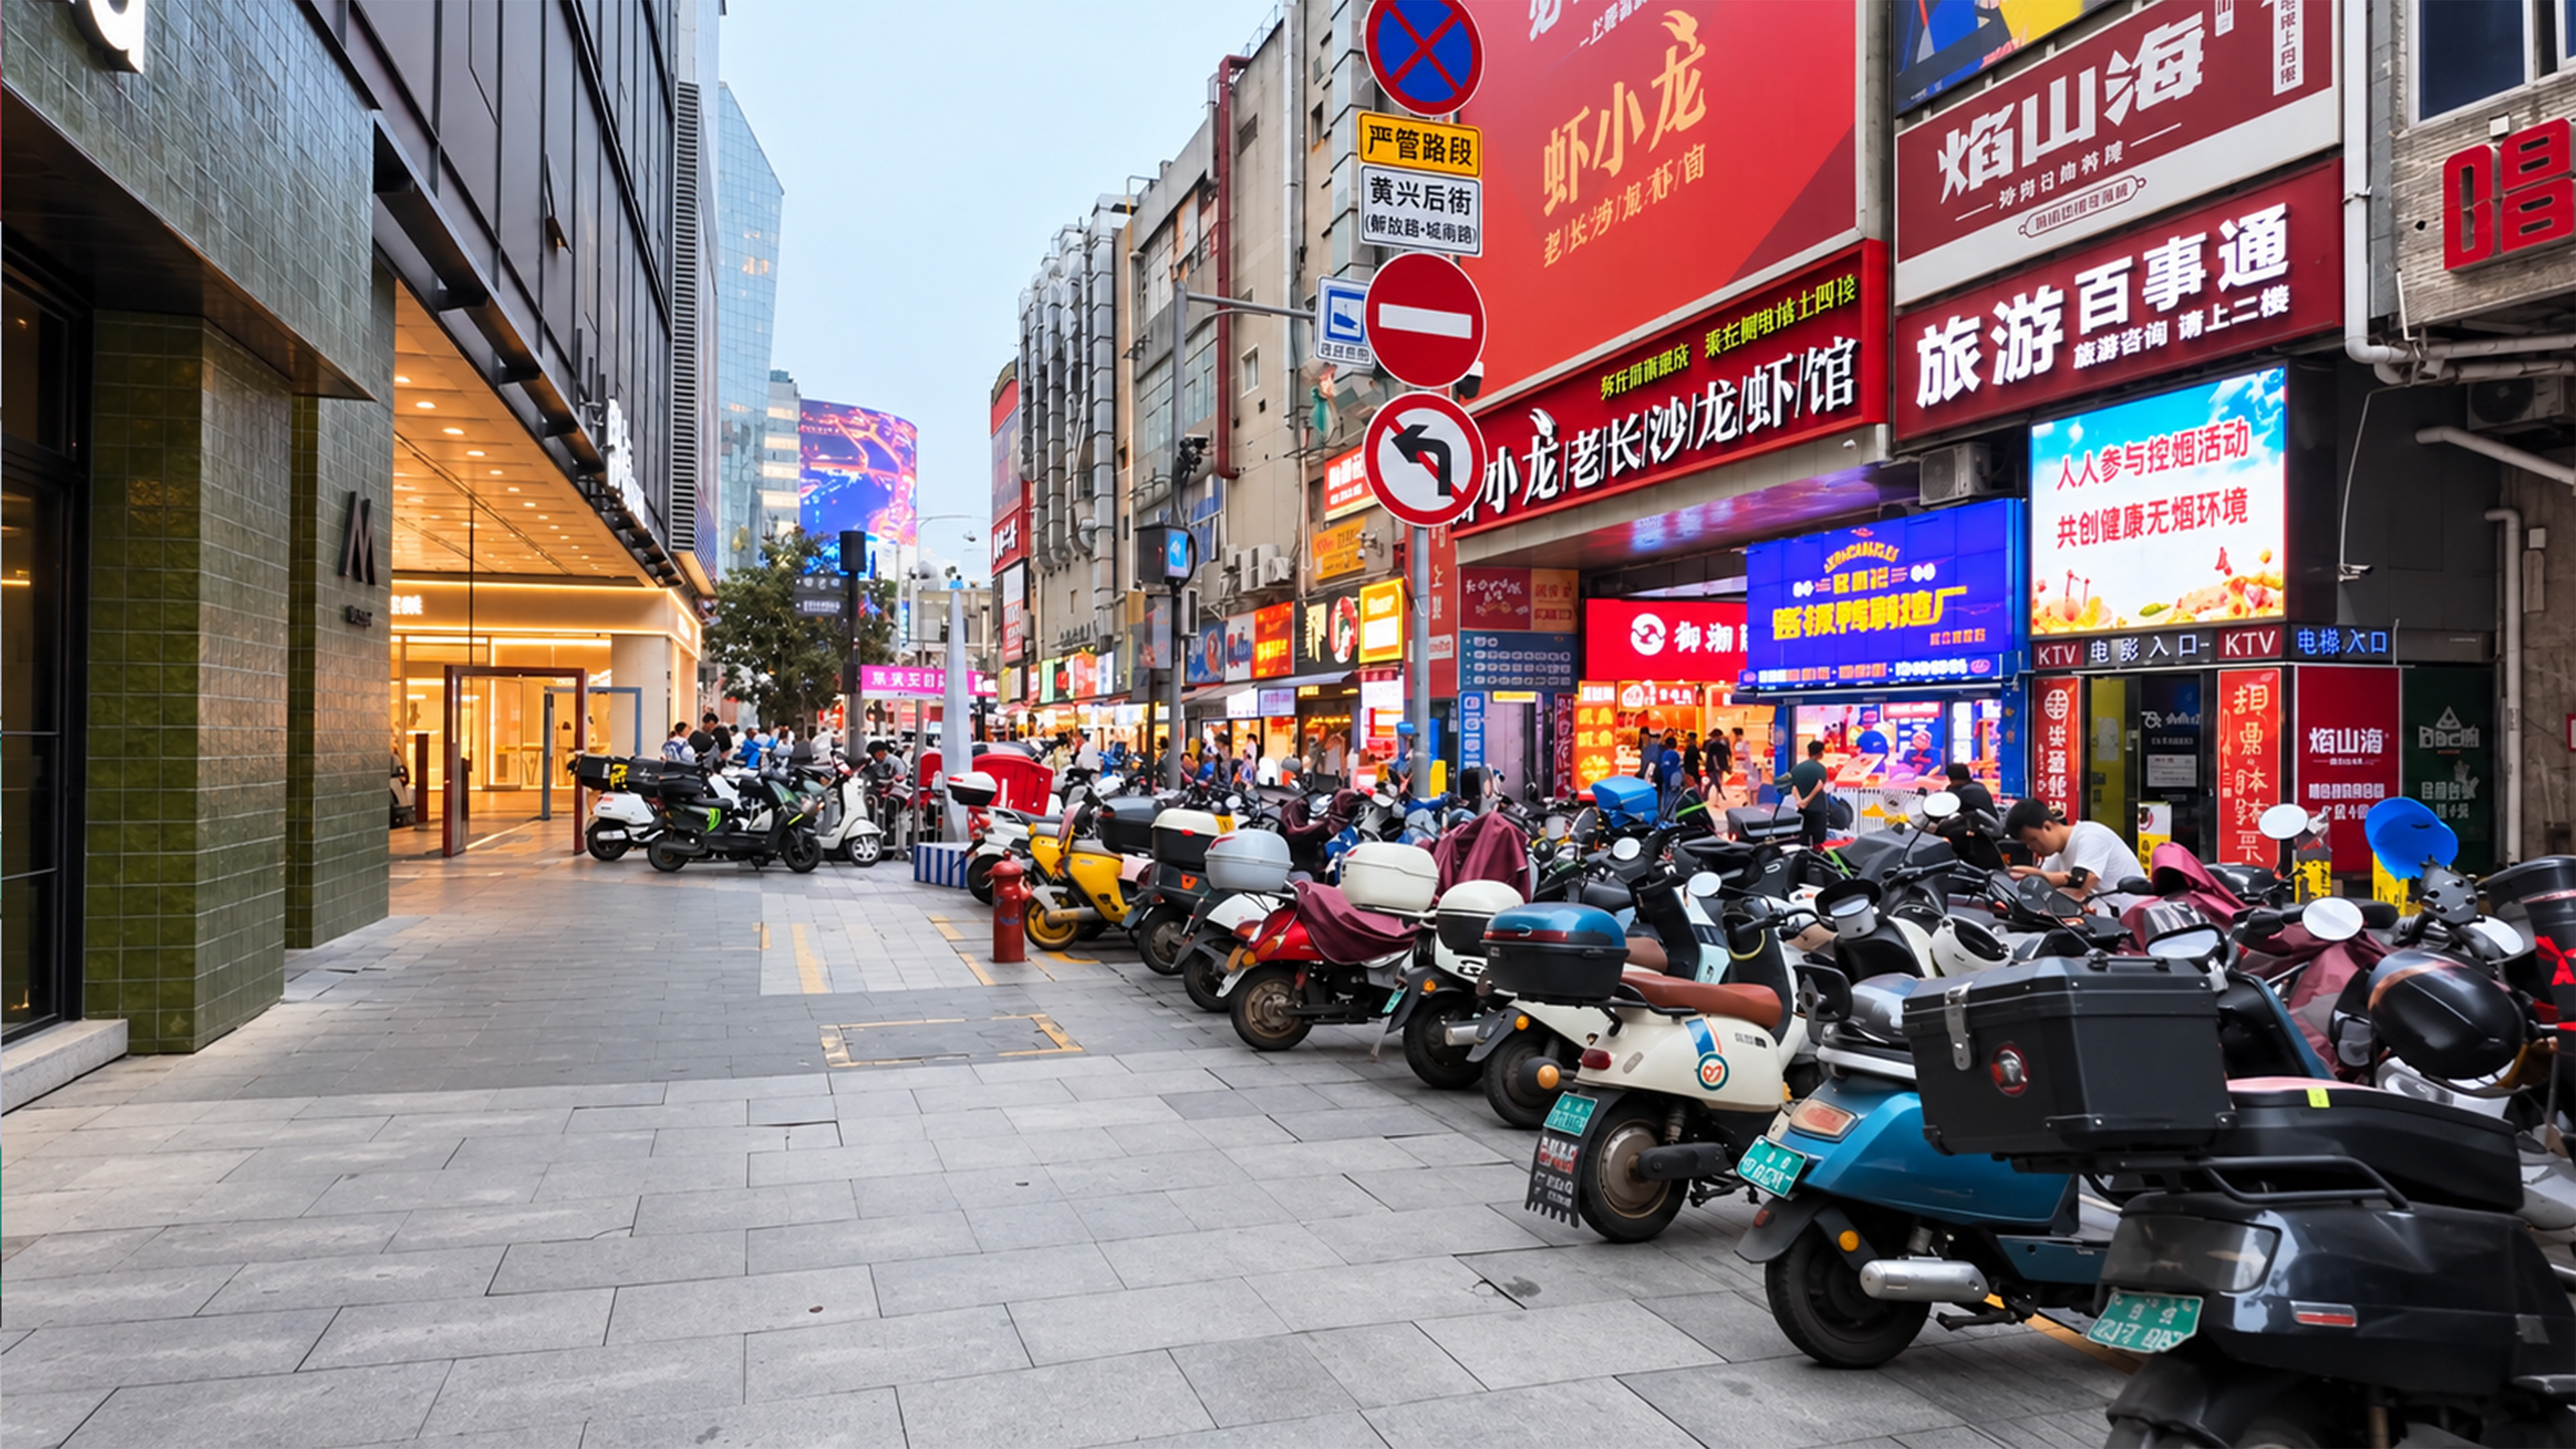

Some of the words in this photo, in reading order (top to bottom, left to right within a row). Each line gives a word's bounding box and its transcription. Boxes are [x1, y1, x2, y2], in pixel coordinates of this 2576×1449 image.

[1544, 11, 1707, 217] 虾小龙
[1937, 11, 2205, 204] 焰山海
[1368, 125, 1472, 166] 严管路段
[1370, 175, 1472, 216] 黄兴后街
[1916, 202, 2290, 409] 旅游百事通
[2073, 320, 2168, 370] 旅游咨询
[2178, 284, 2290, 341] 请上二楼
[2057, 419, 2249, 490] 人人参与控烟活动
[2057, 486, 2249, 549] 共创健康无烟环境
[2037, 645, 2077, 665] KTV
[2225, 631, 2276, 656] KTV
[2298, 628, 2388, 655] 电梯入口
